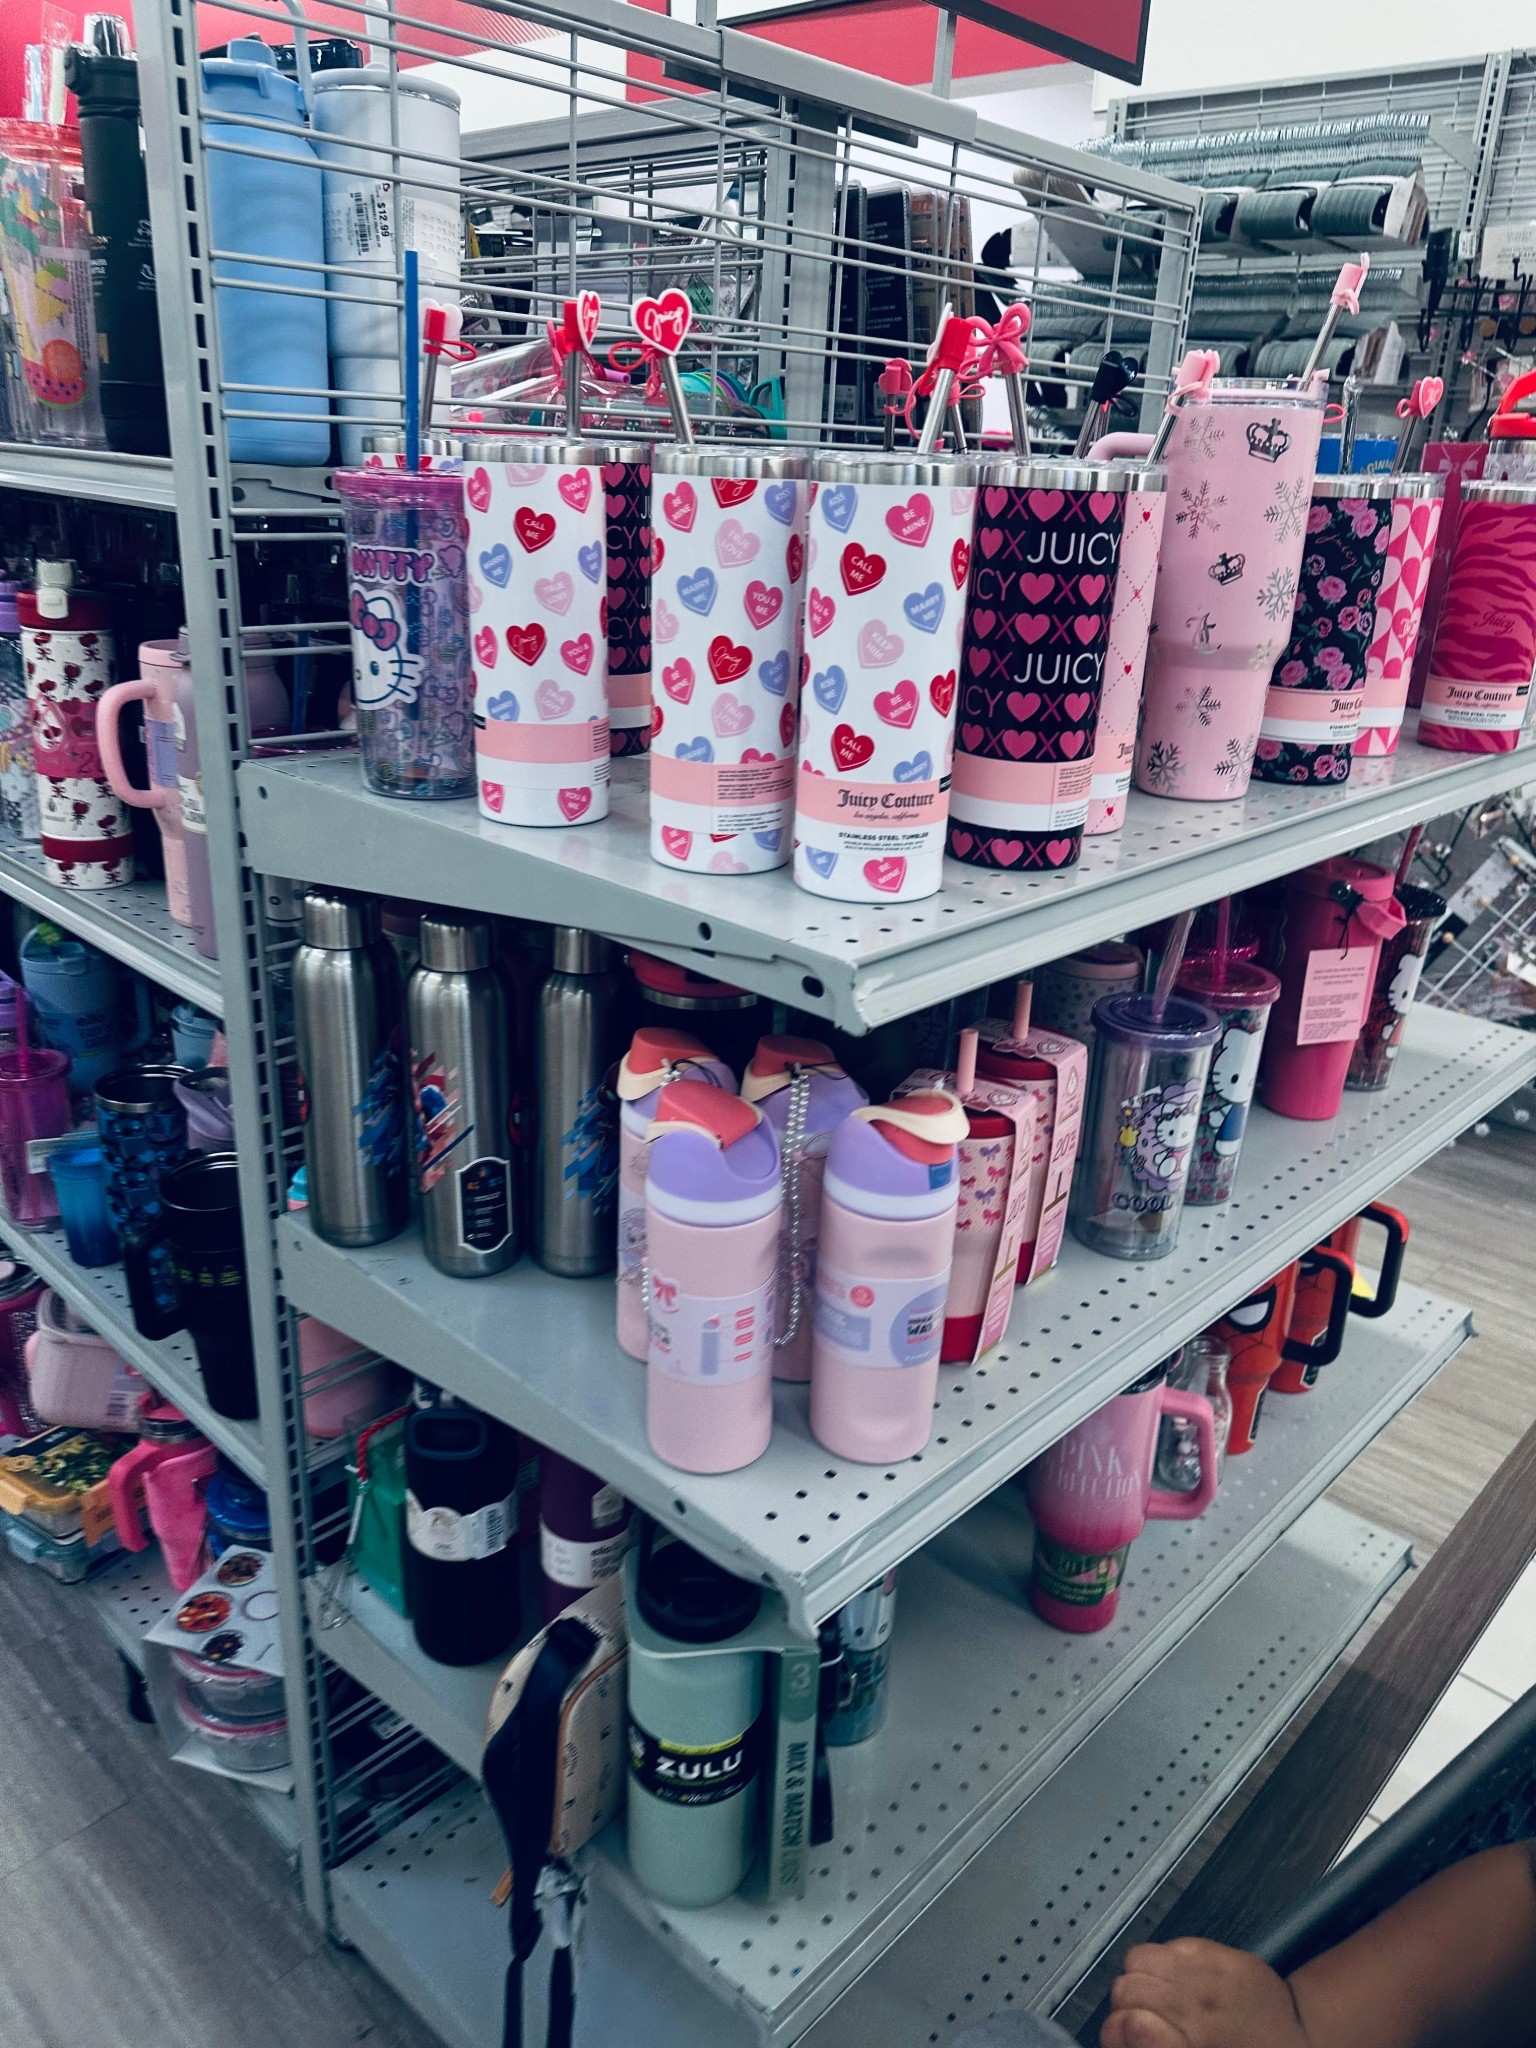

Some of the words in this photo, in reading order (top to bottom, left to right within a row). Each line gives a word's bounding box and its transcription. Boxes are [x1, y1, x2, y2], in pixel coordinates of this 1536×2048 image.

[377, 202, 391, 237] $12.99
[644, 306, 684, 342] Juicy
[564, 480, 580, 492] YOU
[573, 490, 586, 500] ME
[828, 492, 846, 506] KISS
[833, 505, 848, 518] ME
[902, 508, 917, 522] BE
[523, 518, 546, 531] CALL
[901, 516, 928, 537] MINE
[525, 530, 541, 540] ME
[1026, 531, 1122, 566] JUICY
[351, 546, 434, 584] KITTY
[850, 555, 874, 575] CALL
[849, 570, 866, 584] ME
[752, 591, 770, 604] YOU
[910, 592, 941, 615] MARRY
[754, 604, 769, 616] ME
[922, 609, 938, 623] ME
[1473, 611, 1516, 636] Juicy
[871, 631, 894, 651] KEEP
[567, 646, 583, 658] YOU
[714, 645, 743, 673] Juicy
[1013, 651, 1107, 685] JUICY
[889, 693, 904, 706] BE
[1446, 685, 1472, 700] Juicy
[1474, 690, 1513, 701] Couture
[888, 701, 914, 720] MINE
[1330, 698, 1354, 713] Juicy
[840, 735, 863, 754] CALL
[839, 747, 854, 762] ME
[564, 790, 580, 802] YOU
[836, 788, 878, 811] Juicy
[881, 792, 935, 809] Couture
[567, 801, 580, 811] ME
[838, 831, 877, 842] STAINLESS
[878, 832, 900, 842] STEEL
[901, 831, 930, 841] TUMBLER
[1112, 1190, 1174, 1213] COOL
[655, 1749, 744, 1781] ZULU
[785, 1741, 809, 1775] MIX
[784, 1775, 806, 1790] &
[781, 1791, 806, 1847] MATCH
